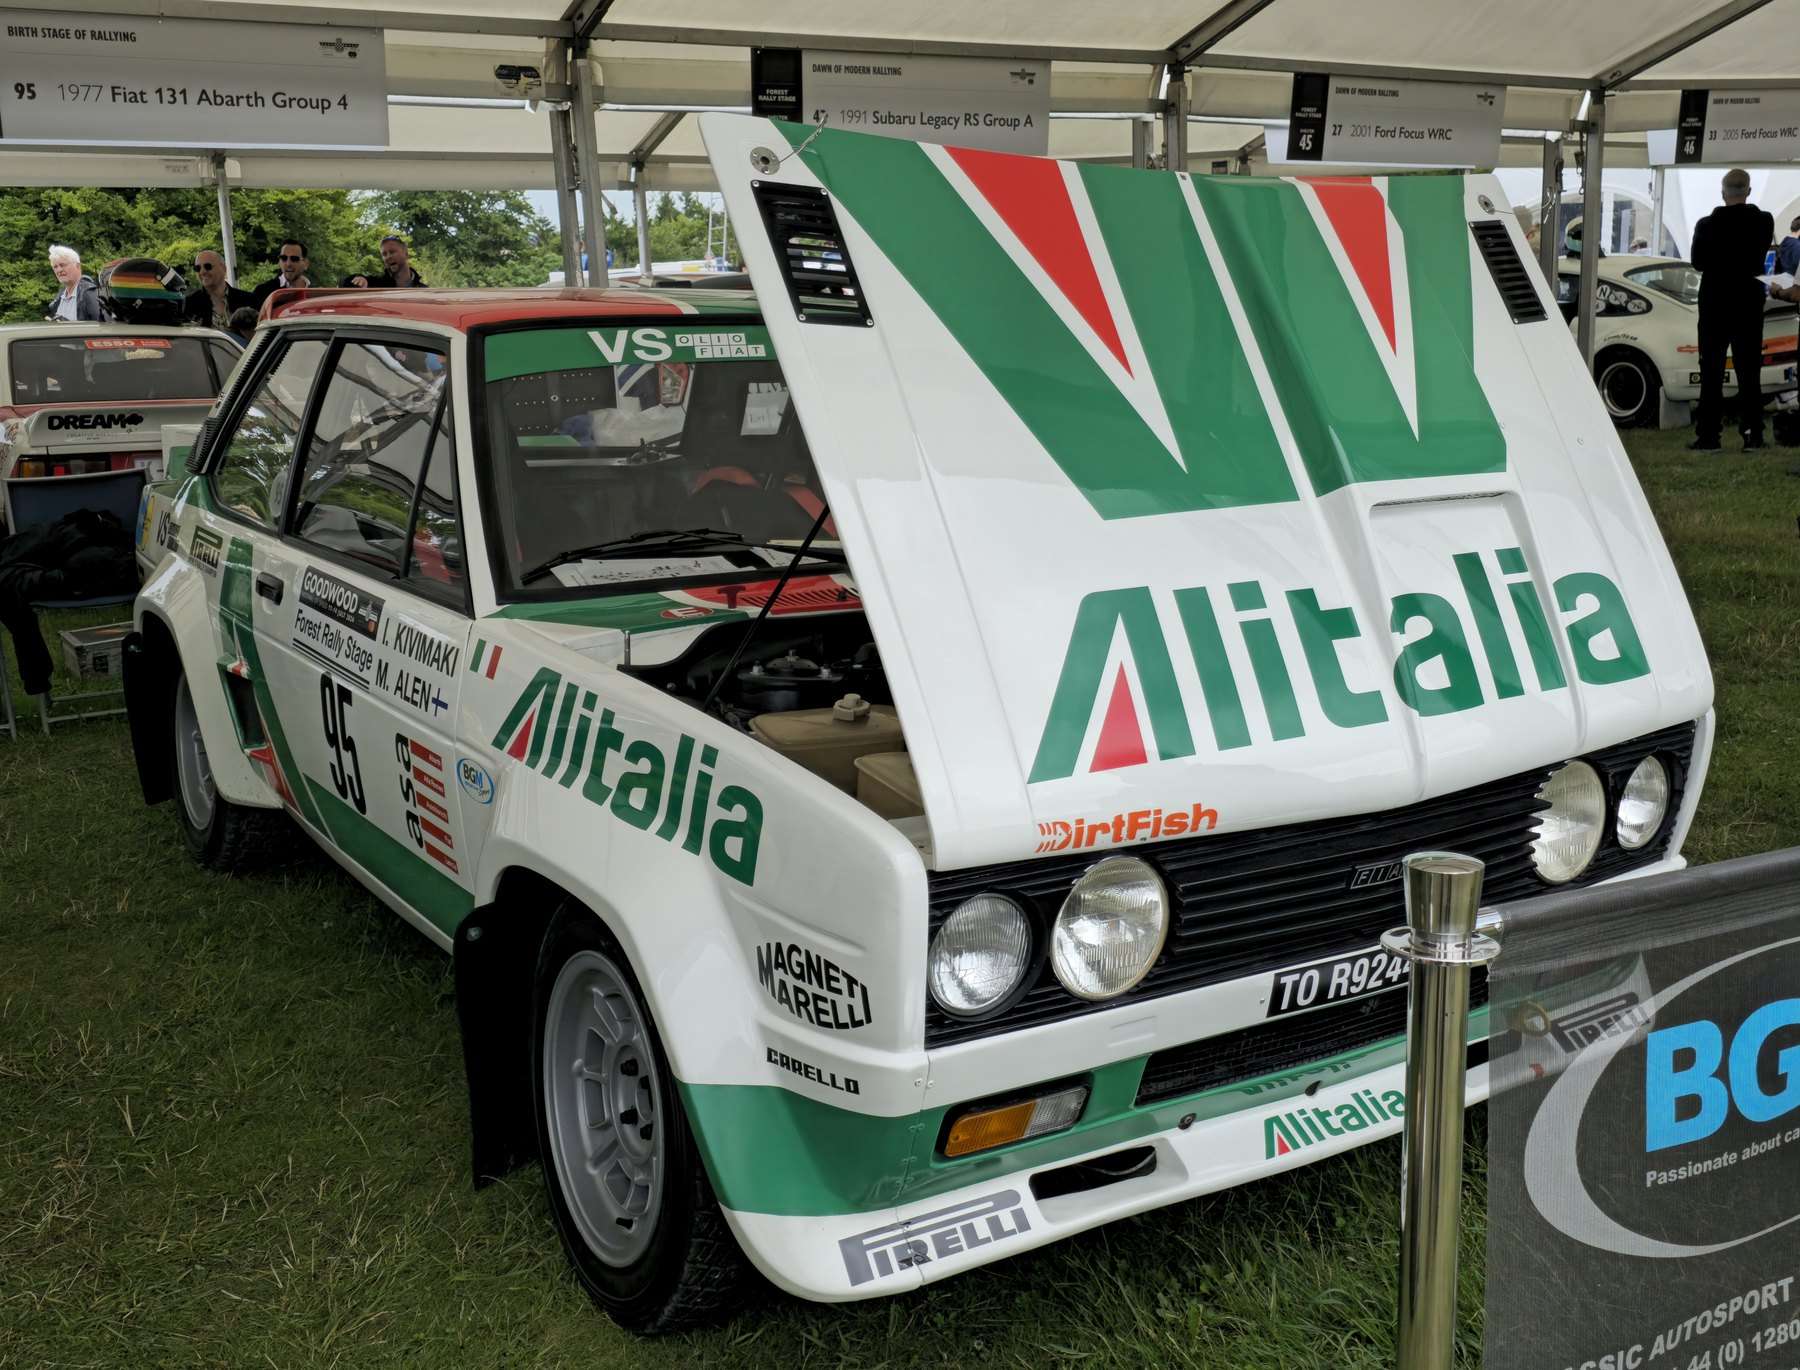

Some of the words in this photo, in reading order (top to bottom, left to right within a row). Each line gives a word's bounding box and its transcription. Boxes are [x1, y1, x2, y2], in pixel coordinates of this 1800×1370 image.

[7, 26, 38, 39] BIRTH
[41, 27, 71, 40] STAGE
[74, 29, 87, 41] OF
[90, 30, 137, 43] RALLYING
[812, 64, 832, 73] DAWN
[834, 64, 842, 73] OF
[844, 65, 871, 75] MODERN
[872, 66, 902, 76] RALLYING
[14, 83, 37, 101] 95
[57, 83, 104, 103] 1977
[111, 86, 148, 105] Fiat
[154, 87, 189, 106] 131
[197, 88, 266, 109] Abarth
[271, 92, 332, 114] Group
[337, 94, 349, 111] 4
[840, 109, 868, 124] 1991
[872, 111, 917, 126] Subaru
[920, 112, 961, 130] Legacy
[964, 113, 980, 127] RS
[983, 114, 1020, 131] Group
[1023, 115, 1033, 128] A
[1299, 134, 1313, 150] 45
[1332, 124, 1343, 136] 27
[1350, 125, 1372, 137] 2001
[1374, 126, 1396, 139] Ford
[1399, 127, 1425, 140] Focus
[1428, 128, 1453, 141] WRC
[1683, 141, 1695, 155] 46
[1709, 130, 1717, 140] 33
[1740, 128, 1757, 139] Ford
[1758, 128, 1778, 139] Focus
[1780, 127, 1799, 138] WRC
[587, 328, 673, 364] VS
[677, 334, 744, 346] OLIO
[698, 345, 764, 357] FIAT
[47, 414, 127, 431] DREAM
[303, 571, 359, 614] GOODWOOD
[294, 608, 322, 641] Forest
[322, 624, 344, 658] Rally
[345, 635, 373, 672] Stage
[382, 618, 389, 646] I.
[394, 623, 460, 678] KIVIMAKI
[375, 658, 389, 691] M.
[393, 669, 432, 712] ALEN
[1027, 547, 1652, 784] Alitalia
[320, 672, 367, 816] 95
[463, 763, 484, 789] BGM
[491, 666, 764, 887] Alitalia
[1034, 802, 1218, 853] DirtFish
[1356, 864, 1403, 886] FIA
[756, 941, 873, 1001] MAGNETI
[1280, 968, 1320, 1011] TO
[1550, 991, 1651, 1054] PIRELLI
[766, 1046, 860, 1095] CARELLO
[1264, 1089, 1406, 1160] Alitalia
[1645, 1151, 1738, 1188] Passionate
[1741, 1132, 1782, 1161] about
[838, 1189, 1032, 1287] PIRELLI
[1648, 1276, 1795, 1361] AUTOSPORT
[1717, 1338, 1745, 1370] (0)
